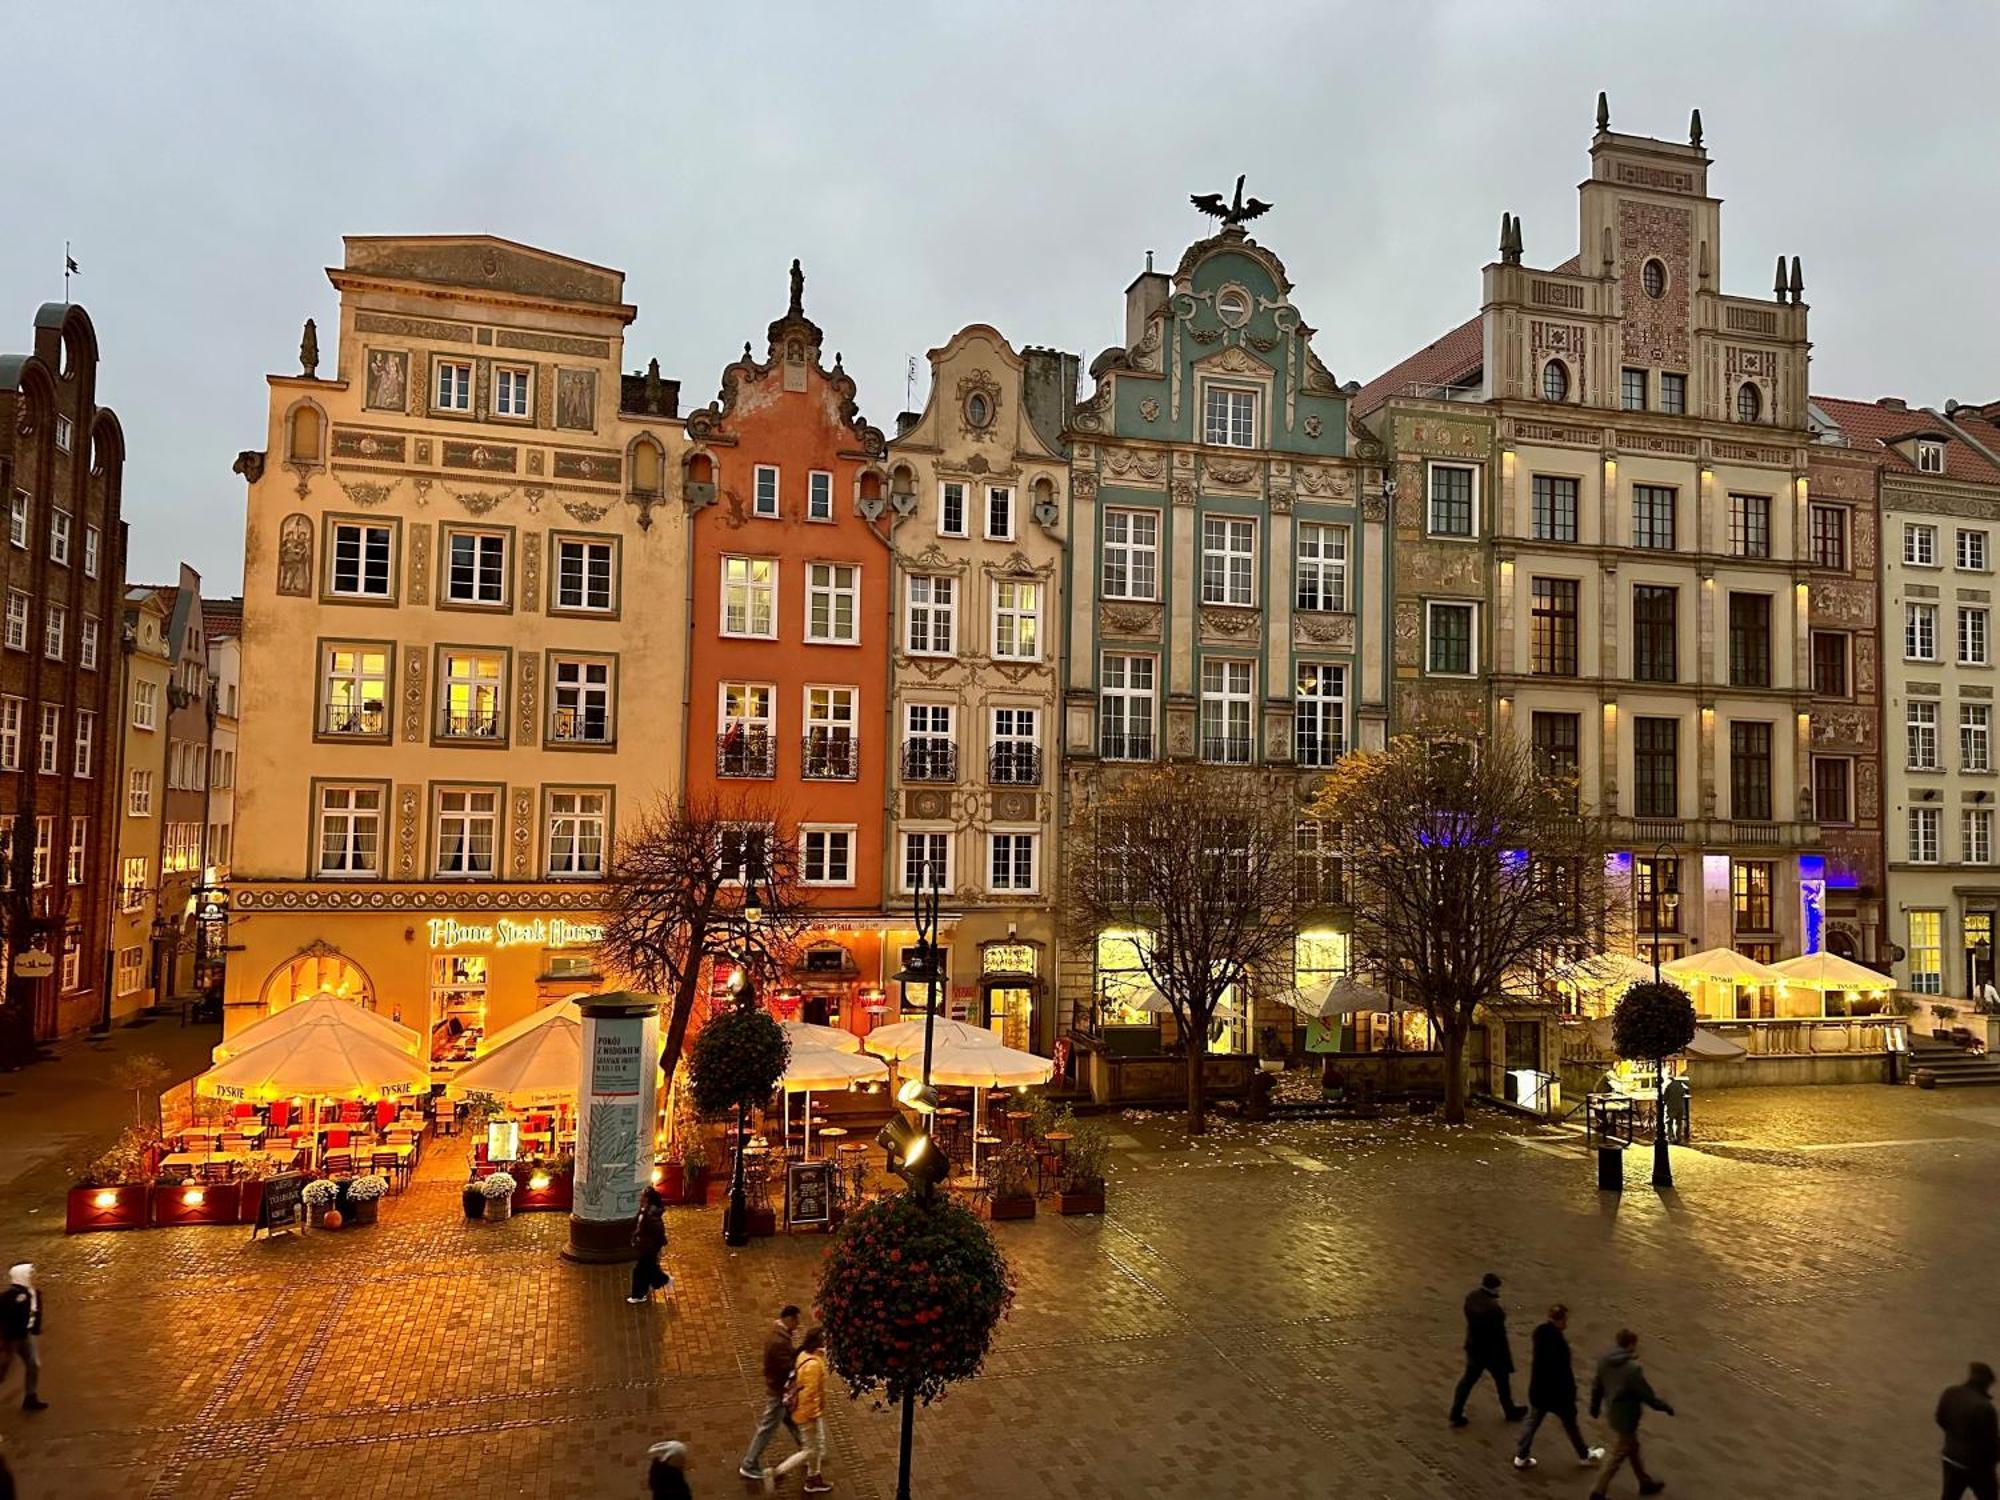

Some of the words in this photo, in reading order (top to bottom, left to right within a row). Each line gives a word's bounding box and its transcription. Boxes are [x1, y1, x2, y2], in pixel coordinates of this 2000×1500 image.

[428, 918, 493, 948] T-Bone
[497, 918, 546, 948] Steak
[216, 1084, 245, 1099] TYSKIE
[381, 1083, 412, 1097] TYSKIE
